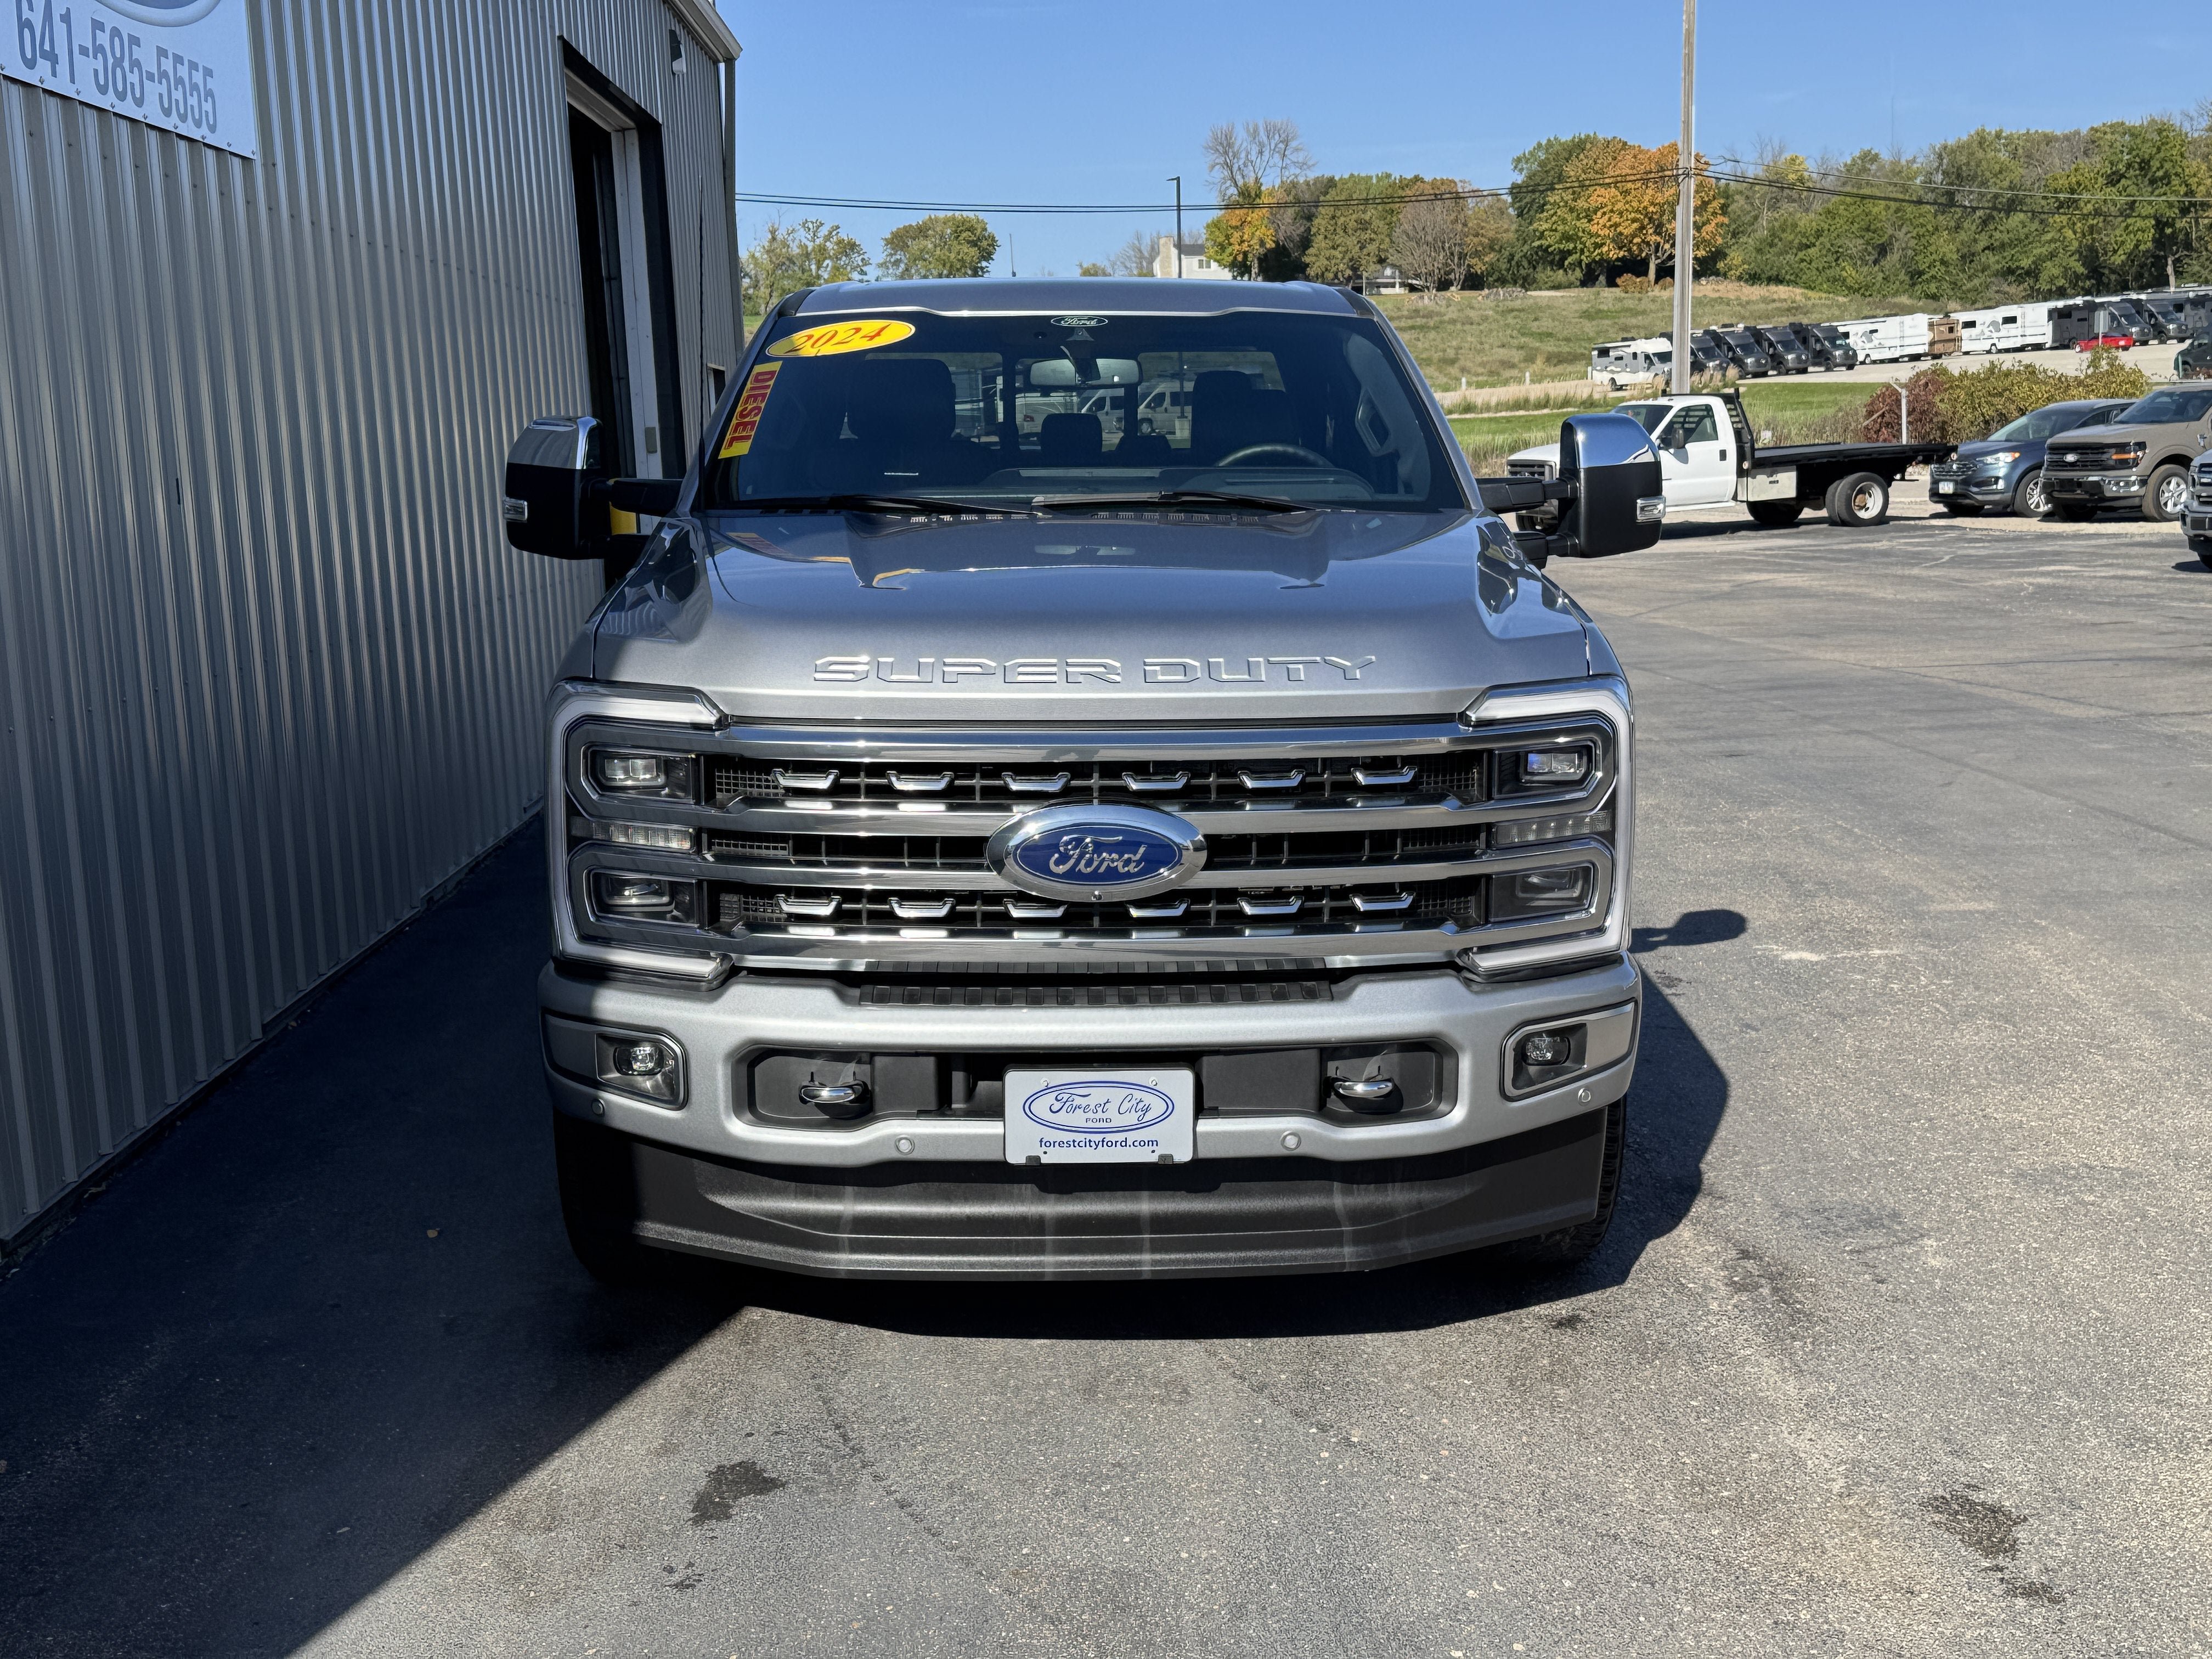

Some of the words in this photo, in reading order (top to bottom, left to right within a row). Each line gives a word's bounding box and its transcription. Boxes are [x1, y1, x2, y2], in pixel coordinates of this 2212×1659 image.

[16, 0, 217, 134] 641-585-5555
[1061, 317, 1097, 325] Ford
[785, 323, 892, 354] 2024
[724, 370, 777, 449] DIESEL
[814, 655, 1122, 683] SUPER
[1143, 655, 1376, 683] DUTY
[1049, 834, 1148, 874] Ford
[1049, 1092, 1112, 1114] Forest
[1118, 1093, 1152, 1122] City
[1039, 1137, 1159, 1150] forestcityford.com
